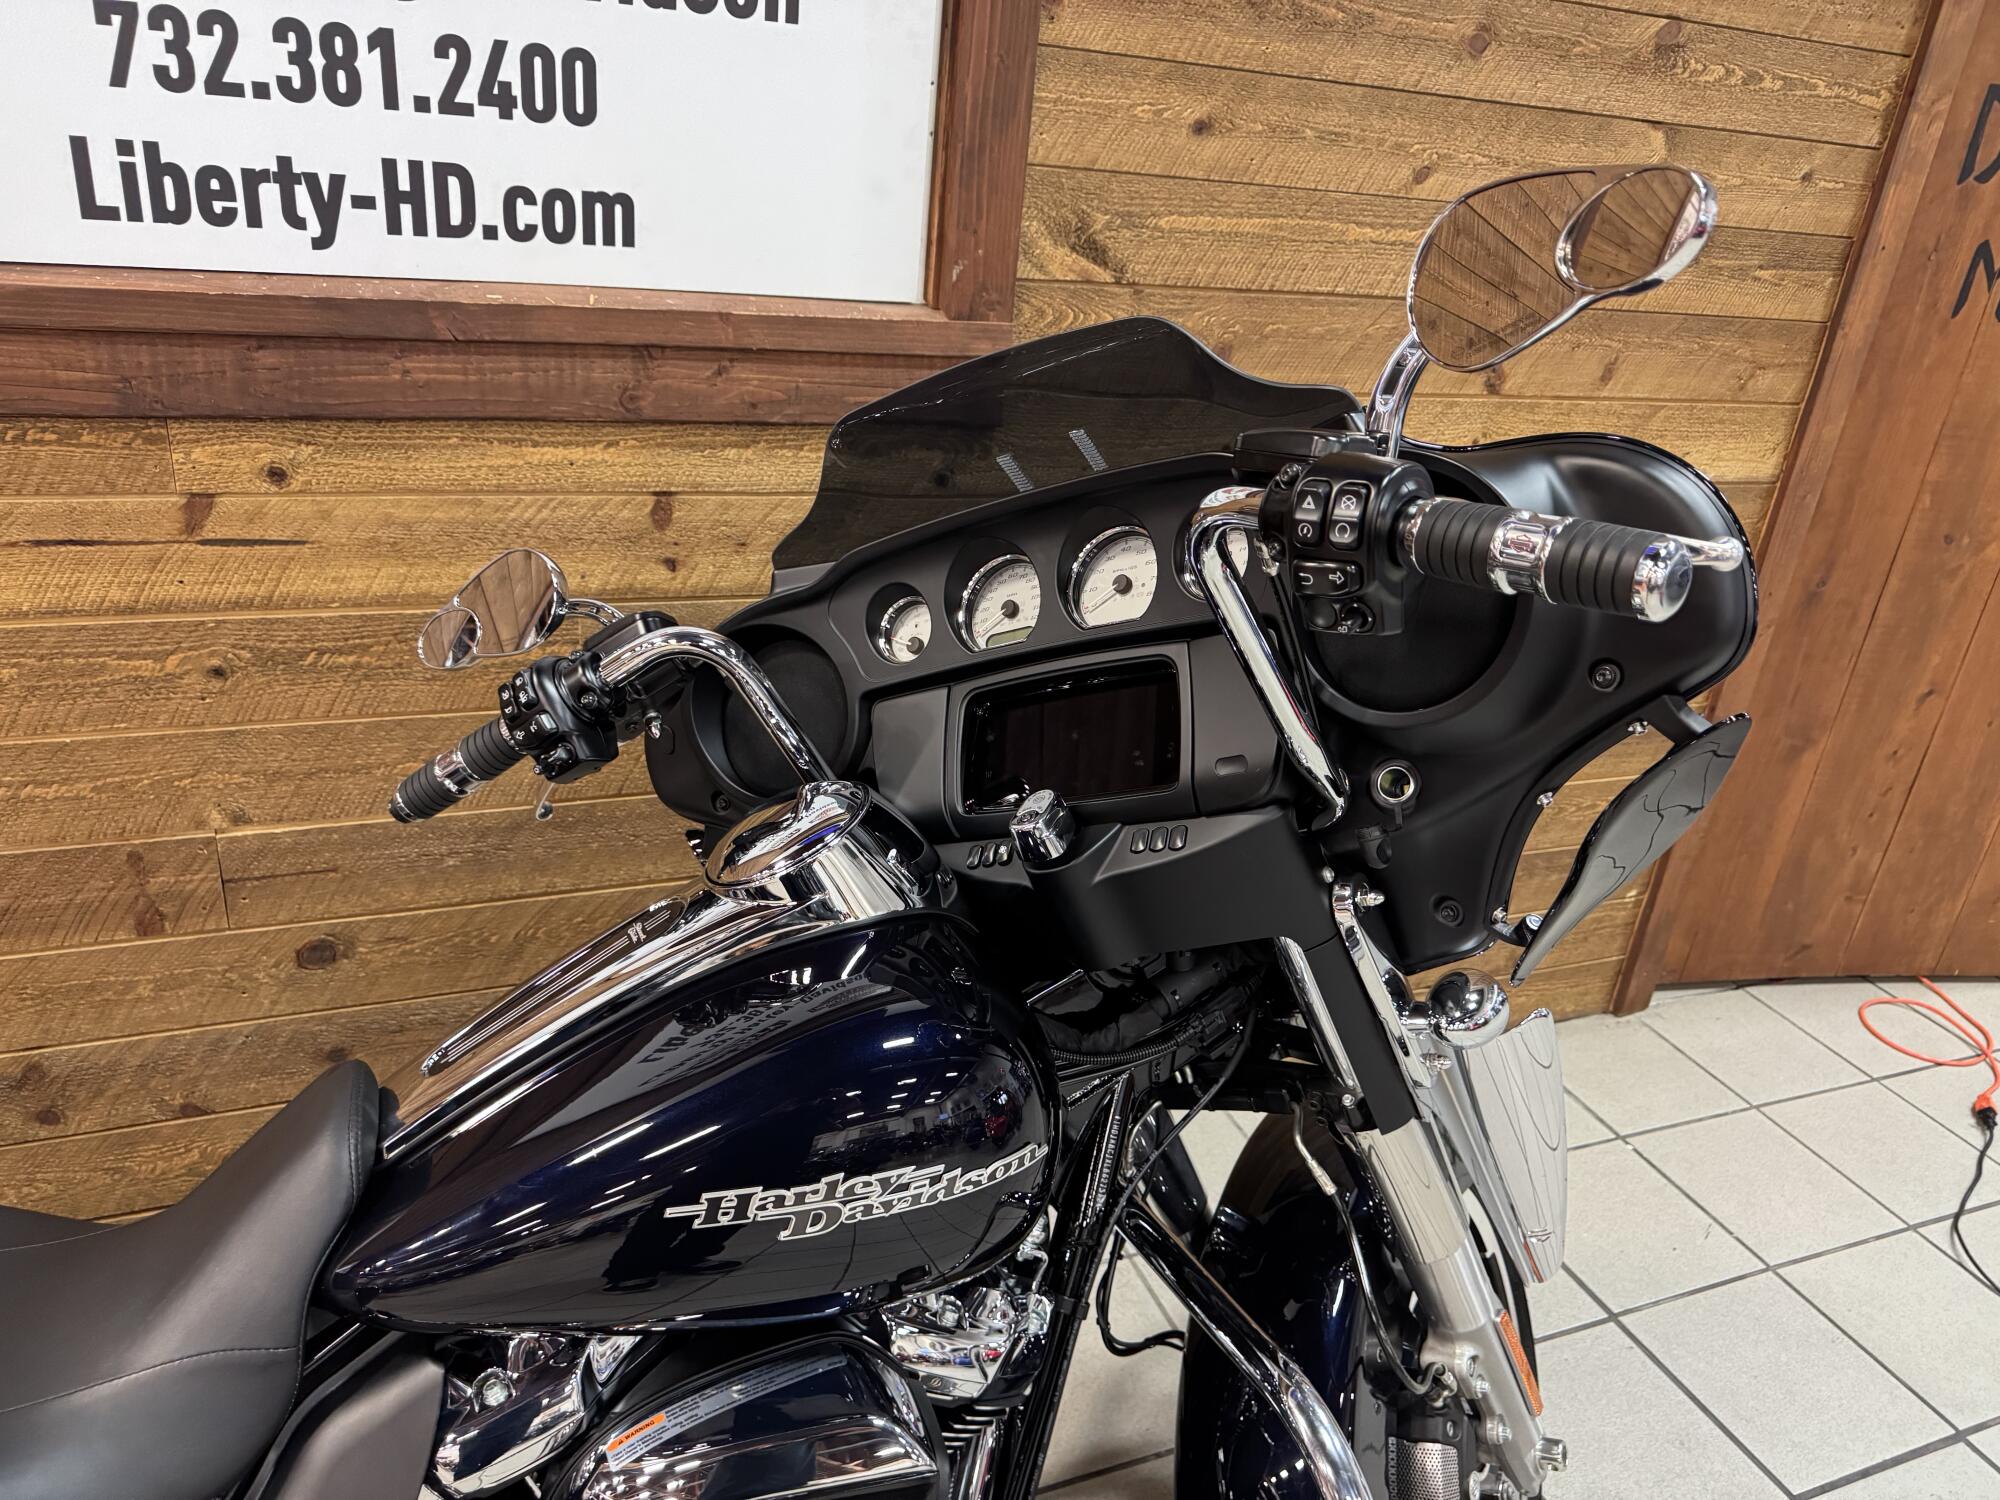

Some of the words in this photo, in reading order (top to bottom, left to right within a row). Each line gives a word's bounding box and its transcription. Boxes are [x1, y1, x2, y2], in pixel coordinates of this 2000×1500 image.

[94, 0, 598, 128] 732.381.2400
[69, 135, 636, 251] Liberty-HD.com
[664, 1164, 945, 1230] Harley
[763, 1143, 1049, 1241] Davidson
[624, 1419, 655, 1440] WARNING
